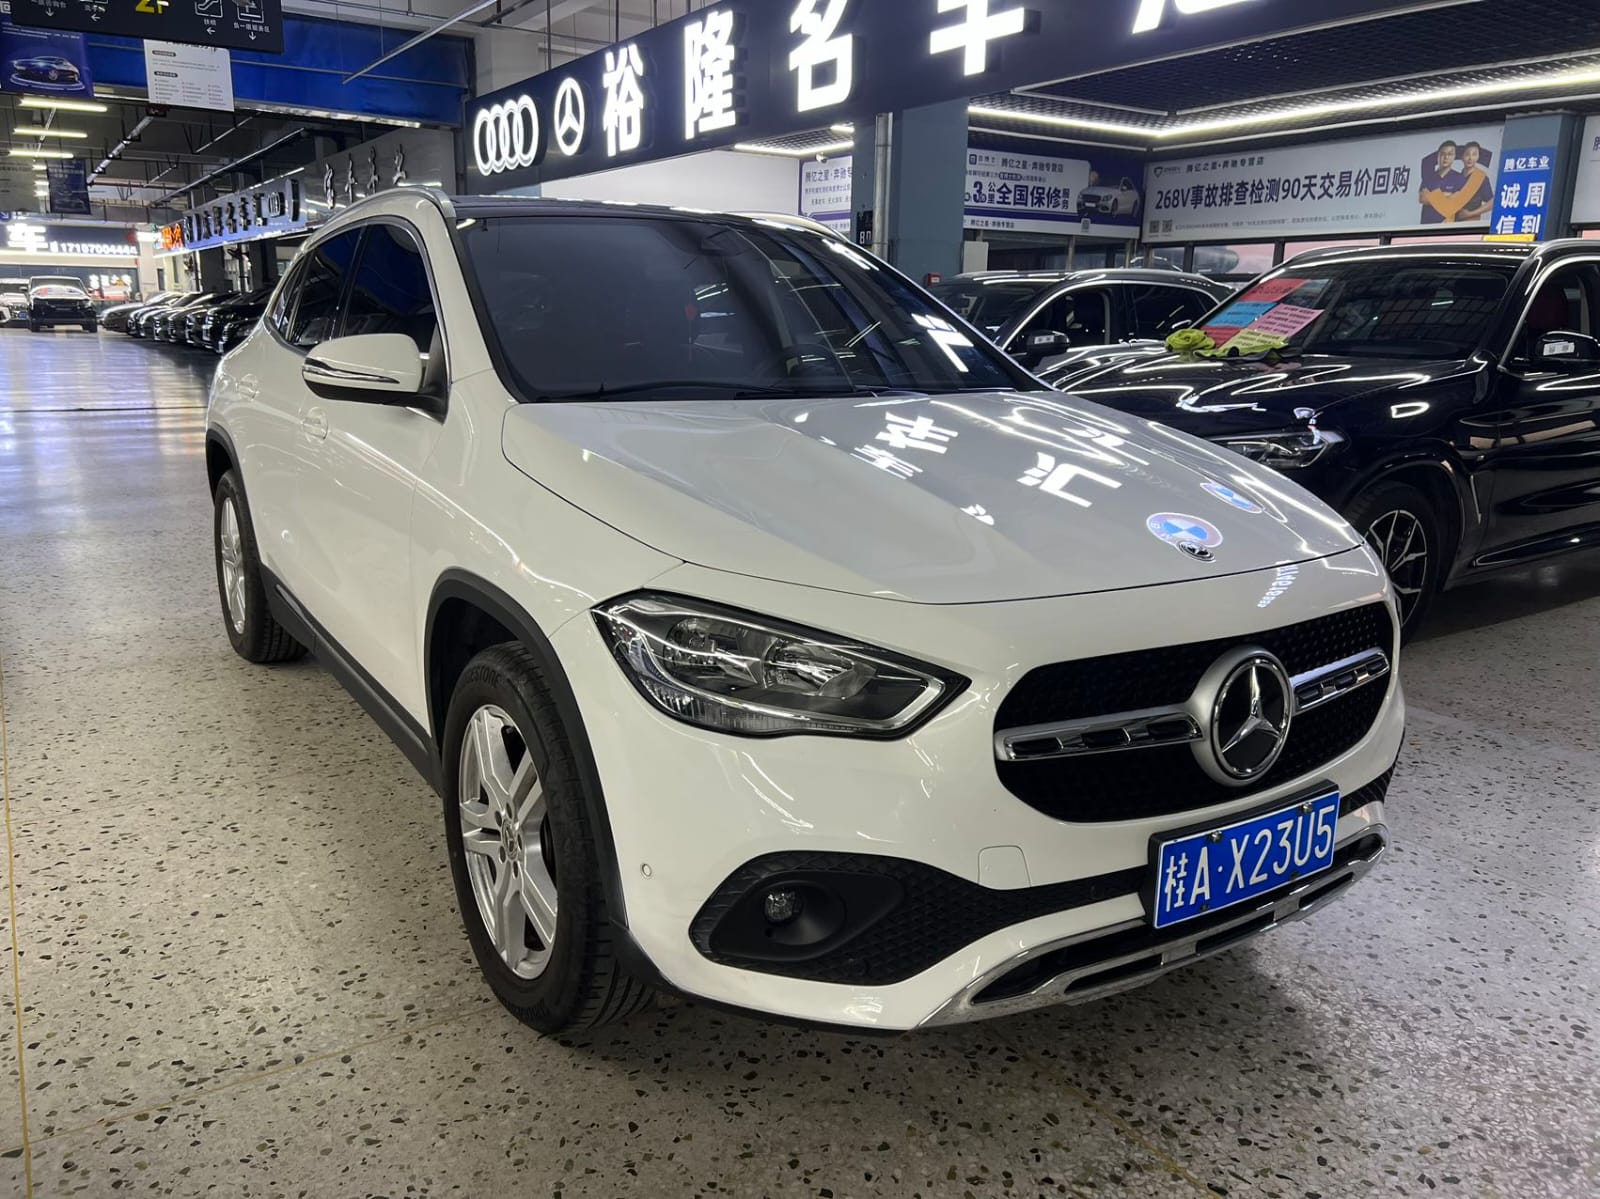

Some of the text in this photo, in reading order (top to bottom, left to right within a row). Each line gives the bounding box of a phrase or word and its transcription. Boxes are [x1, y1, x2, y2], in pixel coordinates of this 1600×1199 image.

[1504, 155, 1550, 170] 腾亿车业
[1154, 164, 1411, 211] 268V事故排查检测90天交易价回购
[1164, 804, 1336, 913] 桂A·X23U5
